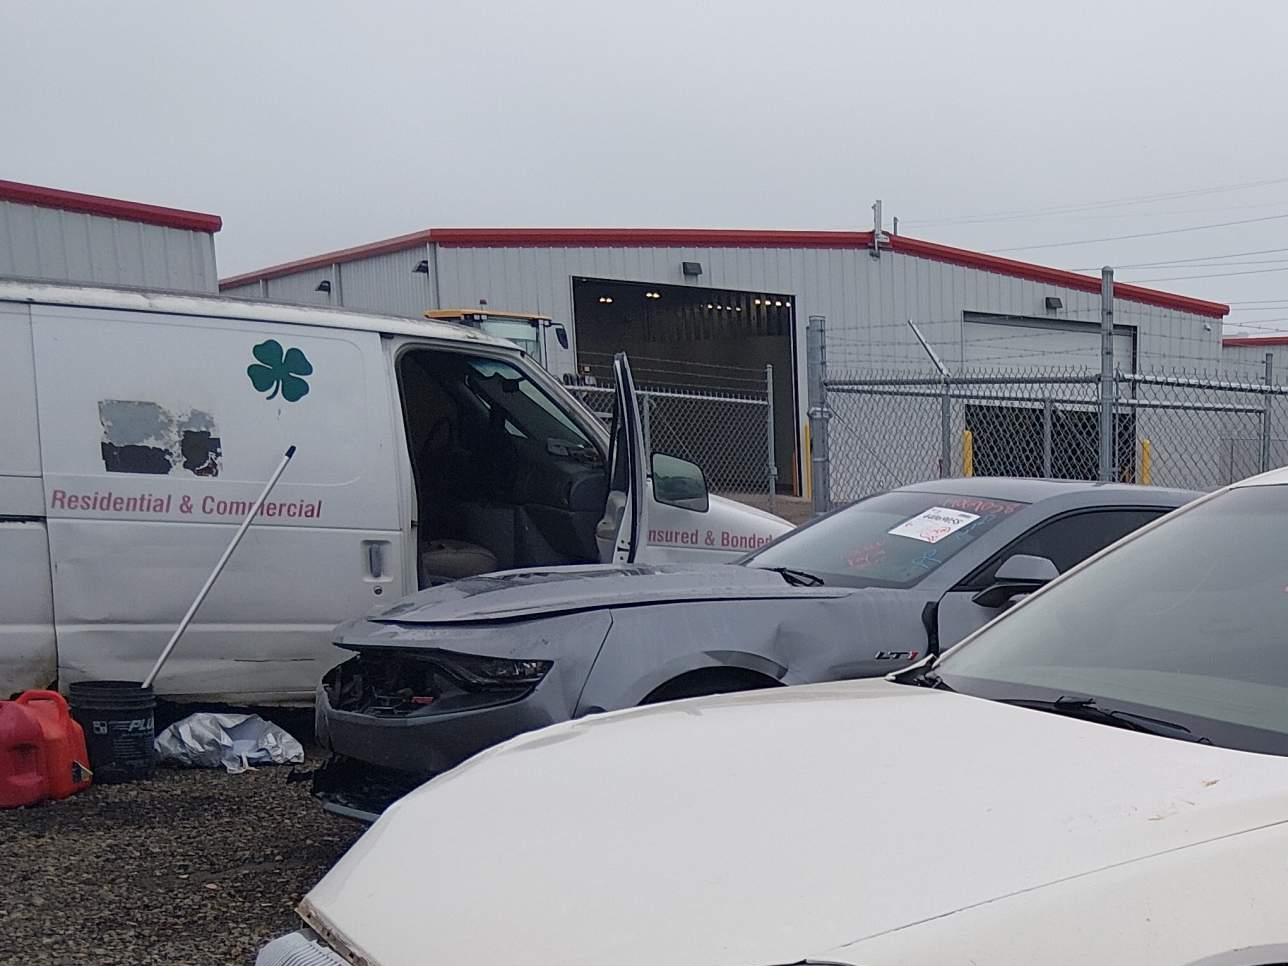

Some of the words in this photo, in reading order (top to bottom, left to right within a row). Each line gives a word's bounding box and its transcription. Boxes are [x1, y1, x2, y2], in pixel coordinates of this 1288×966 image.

[51, 489, 171, 513] Residential
[179, 495, 193, 514] &
[202, 496, 322, 518] Commercial
[648, 529, 699, 545] nsured
[705, 530, 715, 546] &
[875, 651, 919, 660] LT1
